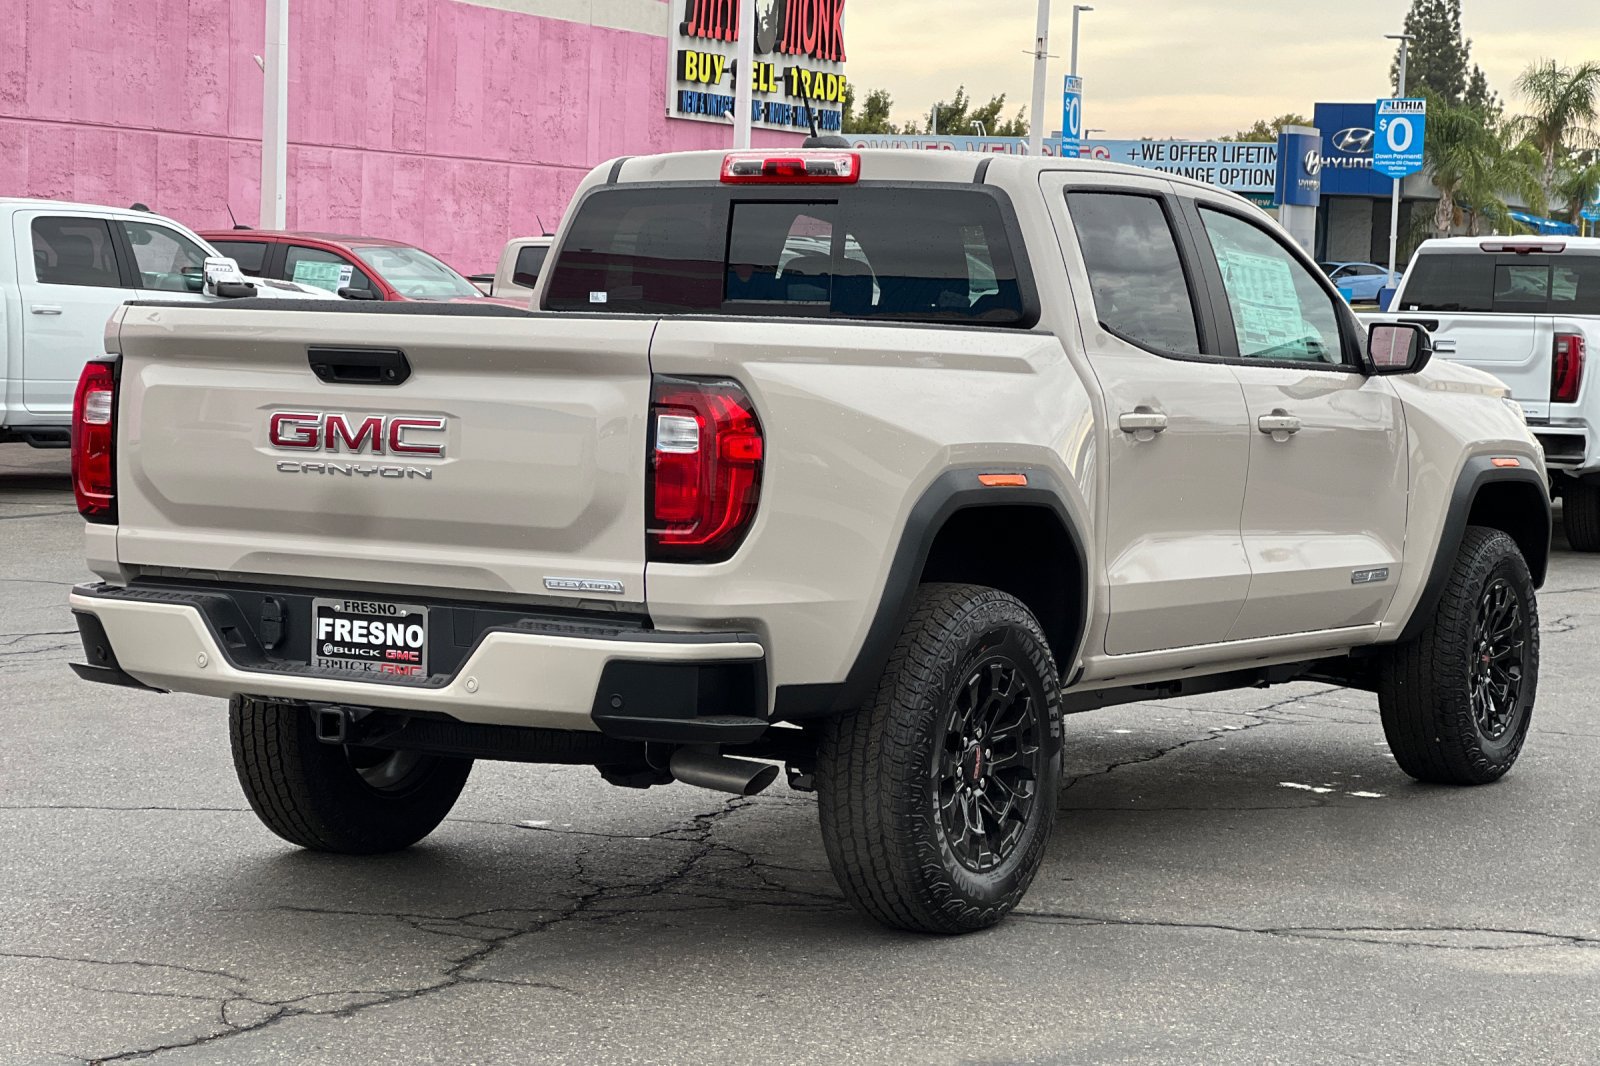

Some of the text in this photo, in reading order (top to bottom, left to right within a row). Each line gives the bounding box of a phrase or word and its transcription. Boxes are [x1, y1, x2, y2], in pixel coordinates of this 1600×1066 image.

[686, 51, 725, 84] BUY
[791, 66, 846, 103] TRADE
[683, 90, 698, 113] NEW
[769, 102, 791, 125] MOVIES
[822, 109, 841, 131] BOOKS
[1392, 101, 1423, 110] LITHIA
[1169, 144, 1217, 163] OFFER
[1222, 146, 1277, 164] LIFETIM
[1320, 157, 1374, 168] HYUND
[1219, 168, 1275, 186] OPTION
[269, 411, 448, 459] GMC
[276, 460, 434, 481] CANYON
[343, 600, 398, 616] FRESNO
[318, 616, 425, 649] FRESNO
[333, 646, 419, 662] BUICK GMC
